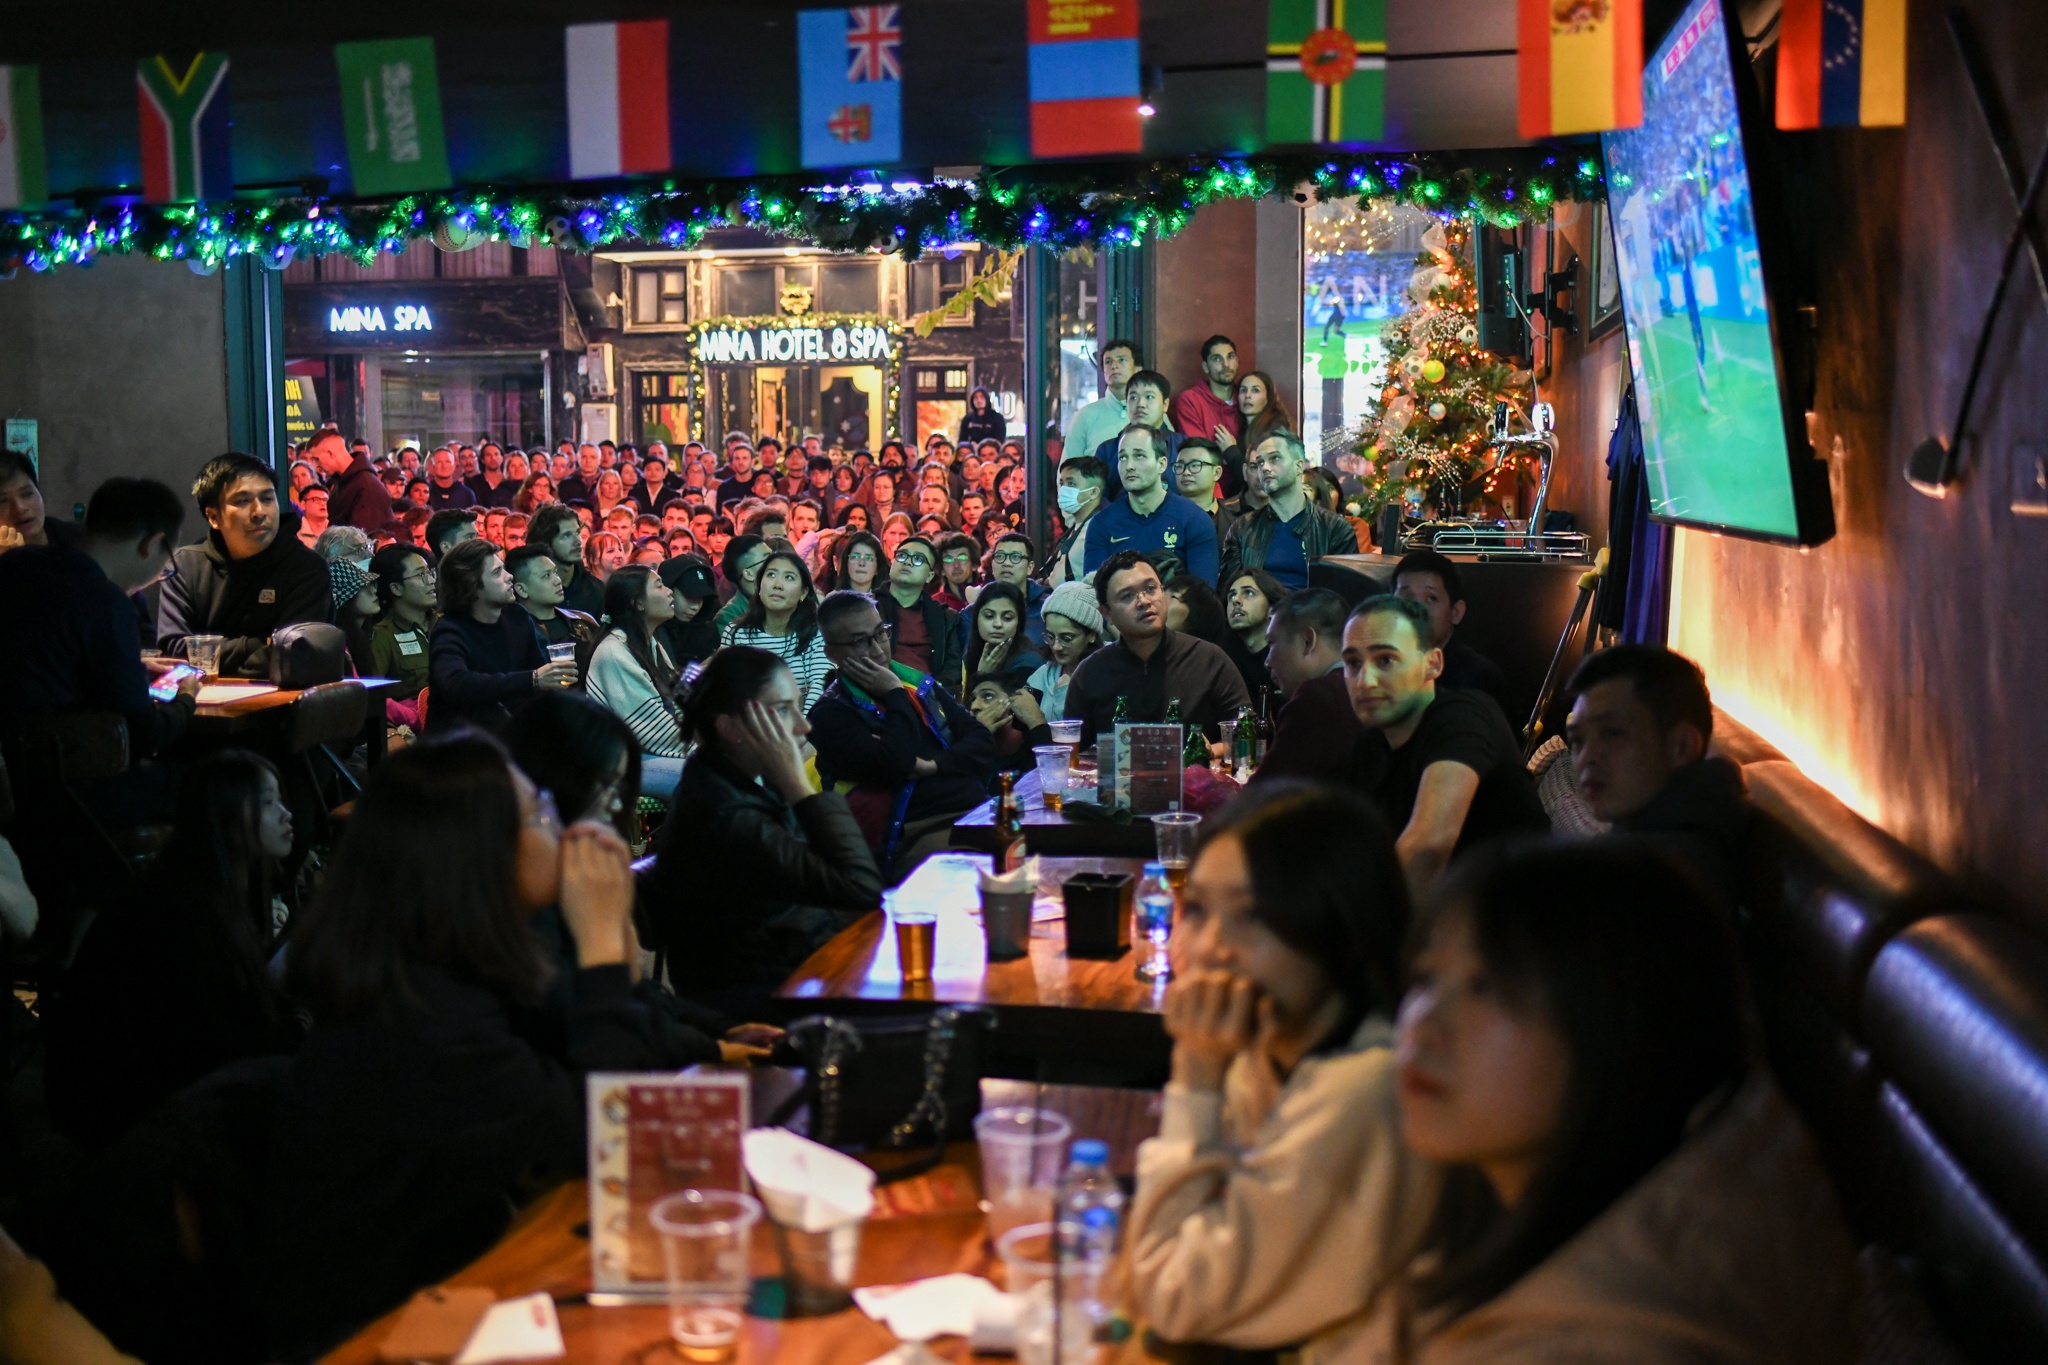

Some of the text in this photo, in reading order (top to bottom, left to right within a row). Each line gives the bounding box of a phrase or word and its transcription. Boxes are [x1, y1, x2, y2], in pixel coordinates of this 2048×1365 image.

[330, 305, 432, 332] MINA SPA
[700, 330, 756, 361] MINA
[761, 328, 829, 360] HOTEL
[849, 327, 891, 359] SPA
